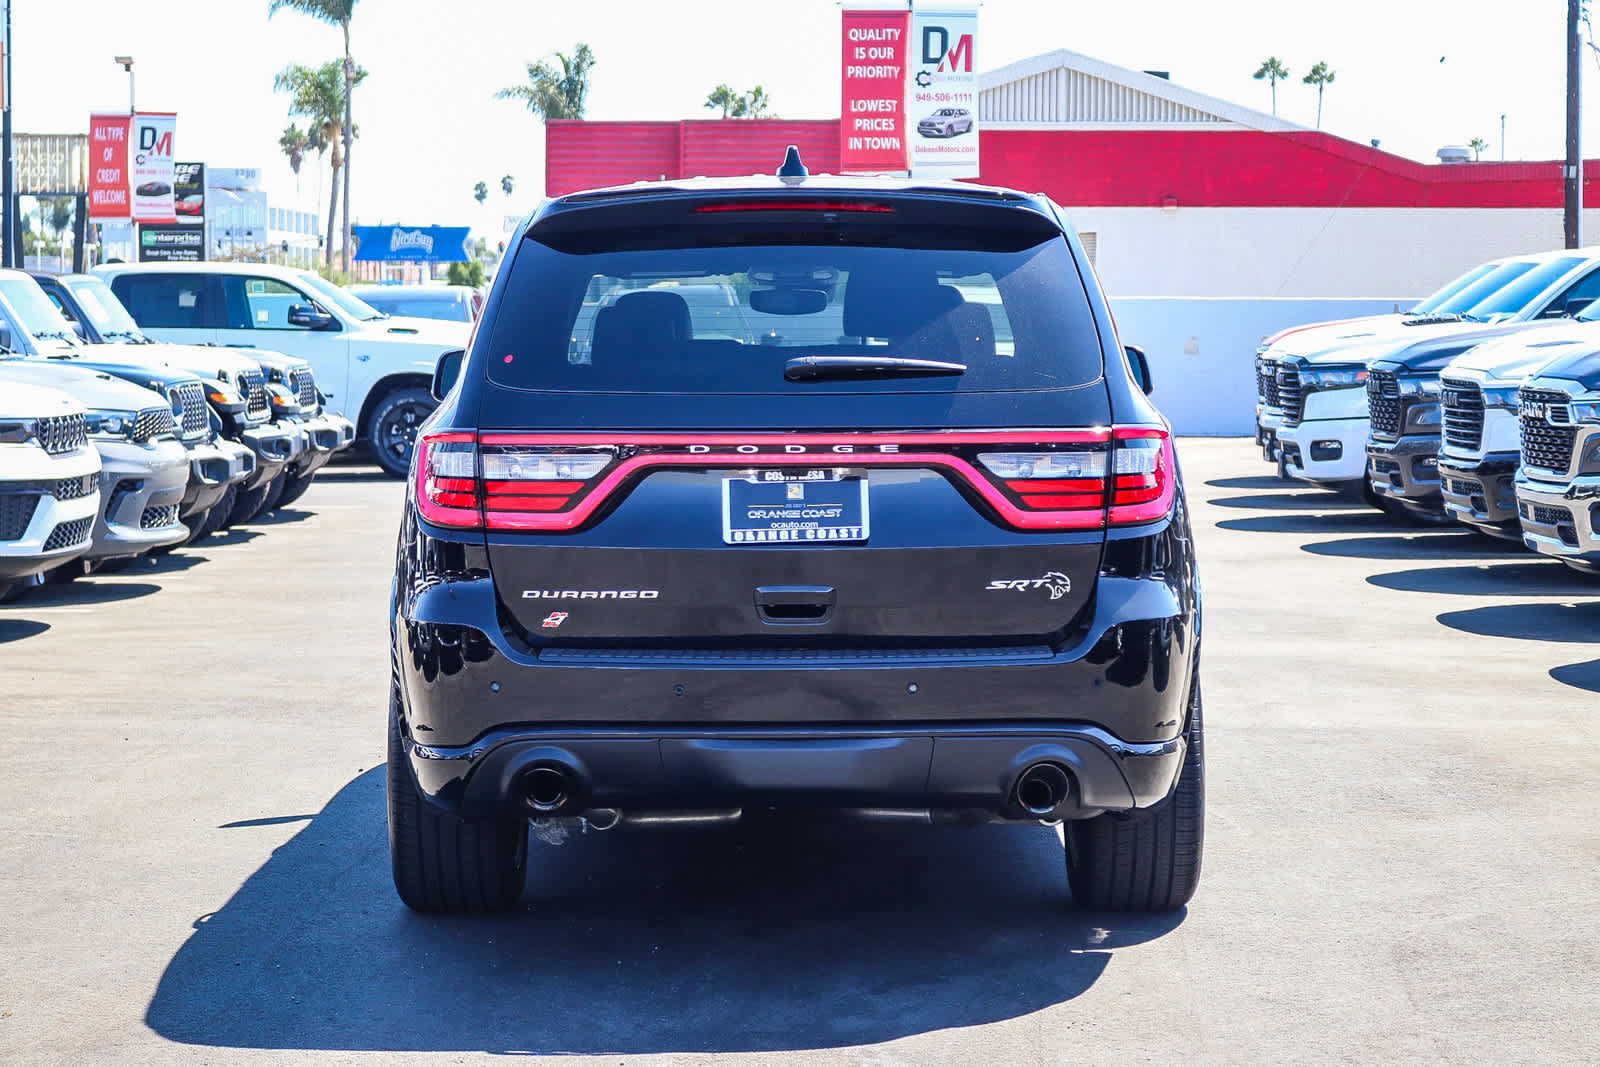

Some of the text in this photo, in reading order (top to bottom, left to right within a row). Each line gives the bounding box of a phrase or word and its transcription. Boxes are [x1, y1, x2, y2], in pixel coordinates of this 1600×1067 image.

[849, 28, 901, 41] QUALITY
[855, 47, 895, 59] IS OUR
[847, 66, 901, 79] PRIORITY
[915, 92, 973, 103] 949-506-1111
[851, 99, 898, 112] LOWEST
[855, 118, 895, 131] PRICES
[95, 127, 124, 141] ALL TYPE
[849, 137, 901, 150] IN TOWN
[104, 148, 113, 162] OF
[97, 168, 121, 183] CREDIT
[93, 190, 126, 204] WELCOME
[144, 232, 201, 244] enterprise
[689, 445, 900, 453] DODGE
[748, 508, 842, 519] ORANGE COAST
[770, 521, 818, 530] ocauto.com
[734, 528, 860, 541] ORANGE COAST
[985, 579, 1051, 592] SRT
[522, 590, 659, 599] DURANGO
